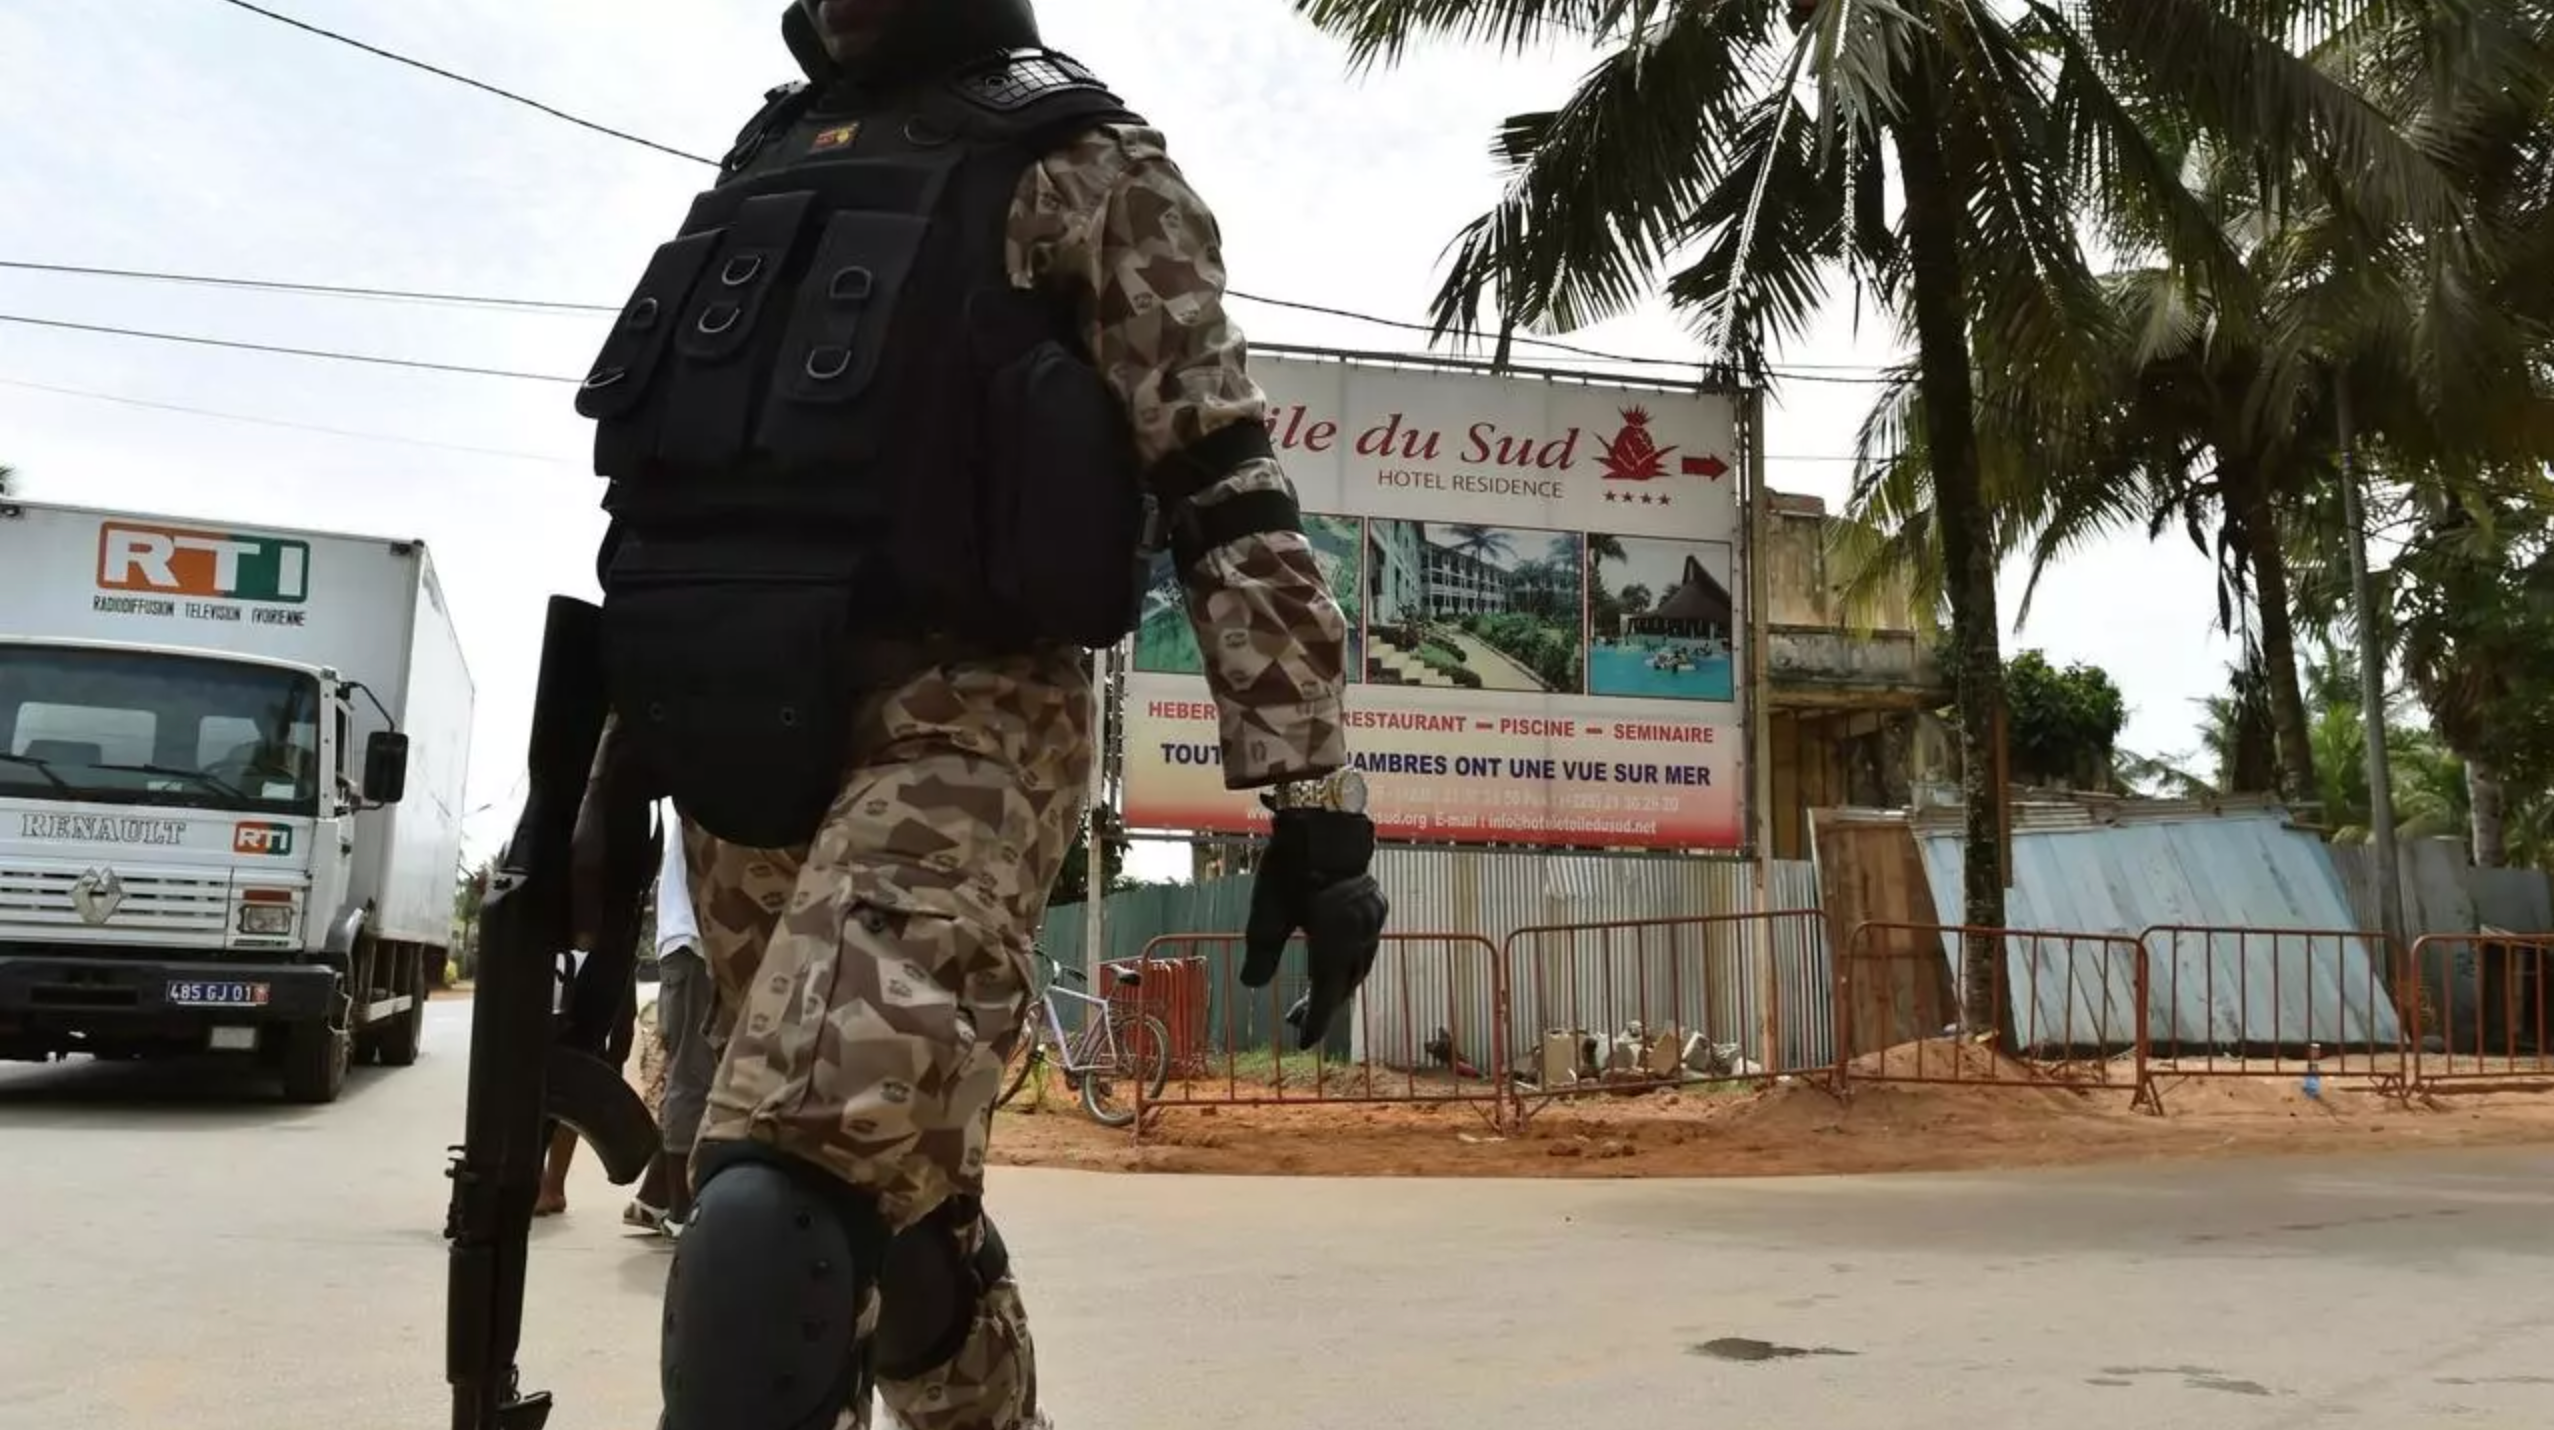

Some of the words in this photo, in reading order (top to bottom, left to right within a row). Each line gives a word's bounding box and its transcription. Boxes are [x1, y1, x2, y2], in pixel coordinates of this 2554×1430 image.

[1265, 405, 1337, 452] ile
[1356, 413, 1441, 460] du
[1461, 421, 1581, 471] Sud
[1377, 468, 1447, 491] HOTEL
[1453, 474, 1565, 499] RESIDENCE
[103, 528, 304, 598] RTI
[93, 595, 175, 617] RADIODIFFUSION
[185, 602, 242, 622] TELEVISION
[1148, 700, 1217, 720] HEBER
[1340, 710, 1467, 733] RESTAURANT
[1500, 717, 1575, 737] PISCINE
[1613, 723, 1714, 743] SEMINAIRE
[1160, 743, 1221, 765] TOUT
[1347, 751, 1448, 776] AMBRES
[1455, 756, 1503, 778] ONT
[1508, 757, 1556, 780] UNE
[1562, 760, 1608, 782] VUE
[1614, 763, 1659, 784] SUR
[1665, 765, 1711, 786] MER
[21, 812, 187, 845] RENAULT
[236, 827, 290, 852] RTI
[207, 985, 228, 1001] GJ
[232, 985, 252, 1002] 01
